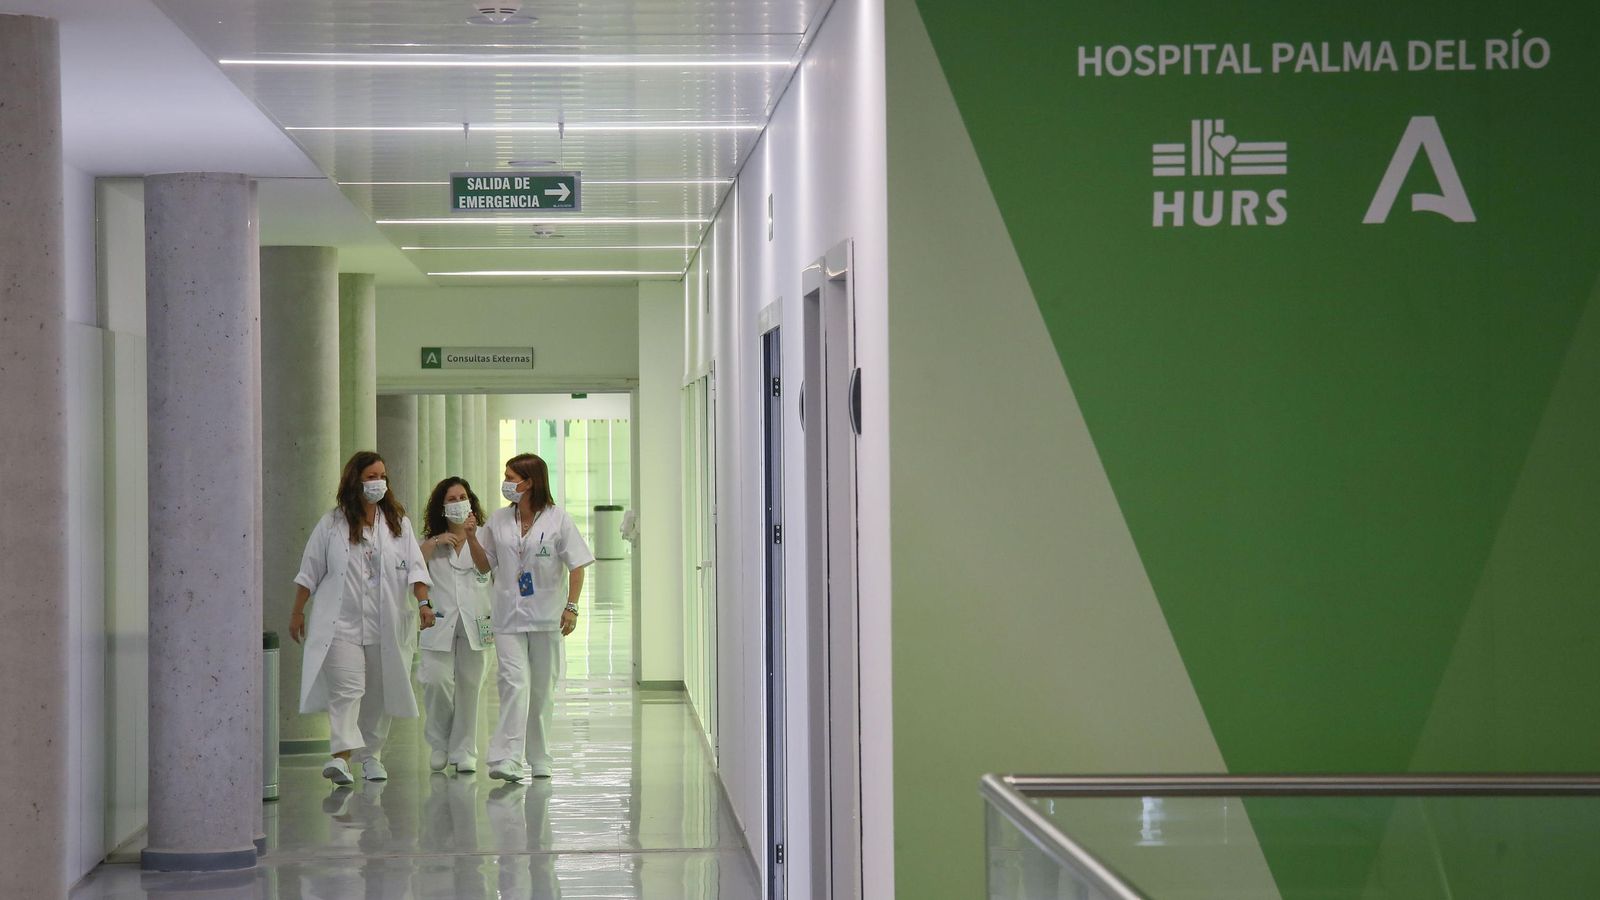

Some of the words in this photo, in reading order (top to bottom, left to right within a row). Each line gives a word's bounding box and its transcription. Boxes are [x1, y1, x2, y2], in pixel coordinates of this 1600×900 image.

[1077, 43, 1262, 77] HOSPITAL
[1271, 40, 1400, 73] PALMA
[1407, 39, 1477, 71] DEL
[1485, 28, 1552, 70] RÍO
[467, 177, 511, 190] SALIDA
[514, 177, 531, 190] DE
[458, 195, 540, 209] EMERGENCIA
[1152, 189, 1288, 227] HURS
[446, 353, 491, 363] Consultas
[492, 354, 531, 363] Externas
